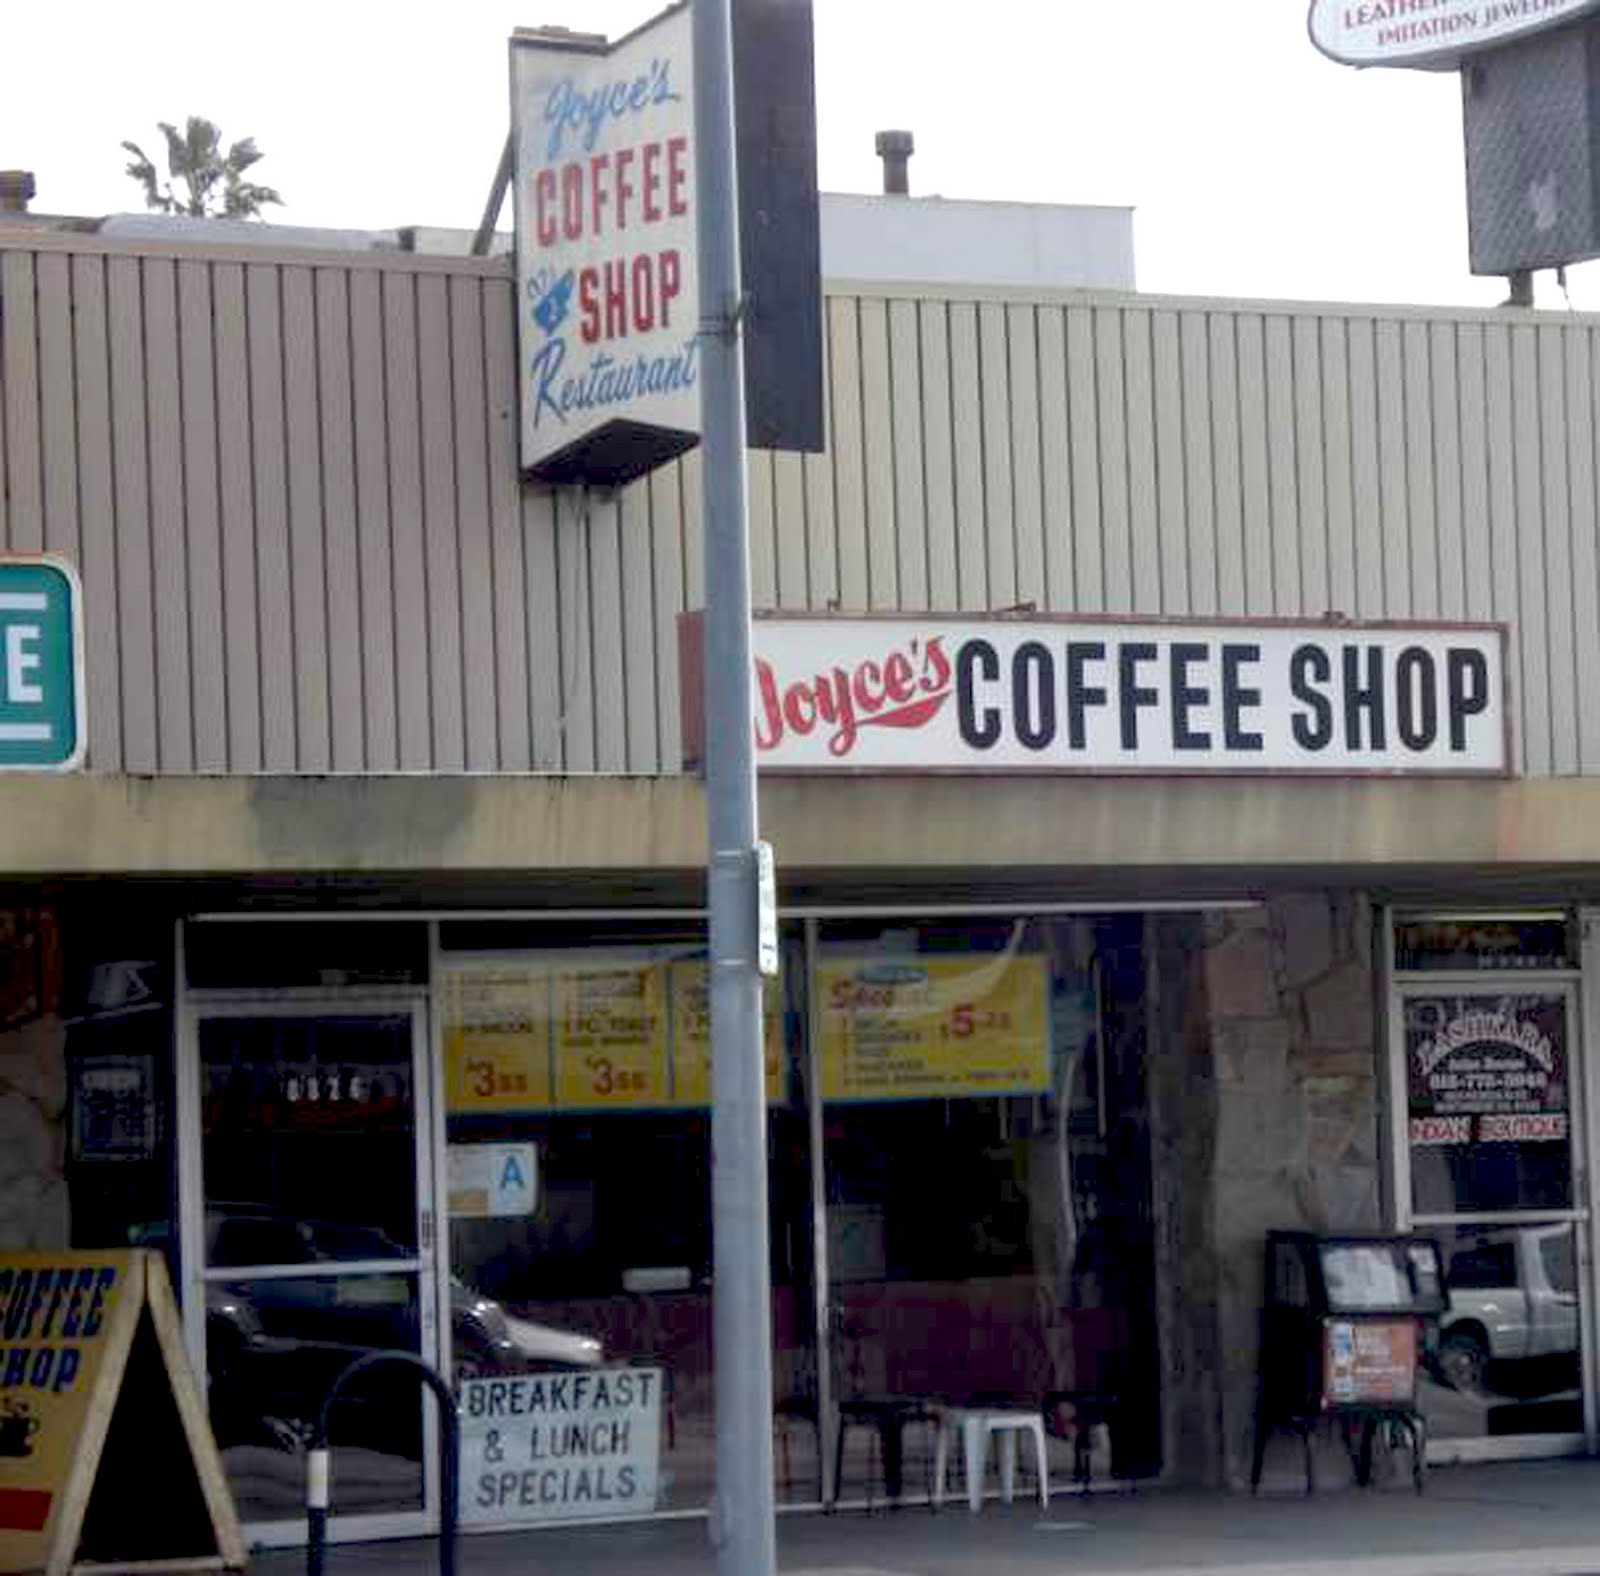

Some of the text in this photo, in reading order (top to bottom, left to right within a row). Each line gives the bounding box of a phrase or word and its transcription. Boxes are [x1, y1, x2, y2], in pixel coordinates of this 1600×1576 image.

[1377, 0, 1565, 46] IMITATION JEWEL
[544, 59, 682, 160] Joyce's
[535, 136, 689, 249] COFFEE
[578, 249, 681, 345] SHOP
[532, 336, 699, 430] Restaurant
[754, 633, 1488, 757] Joyce's COFFEE SHOP
[501, 1153, 525, 1190] A
[0, 1348, 79, 1392] HOP
[468, 1372, 655, 1417] BREAKFAST
[484, 1419, 632, 1463] & LUNCH
[475, 1465, 637, 1507] SPECIALS
